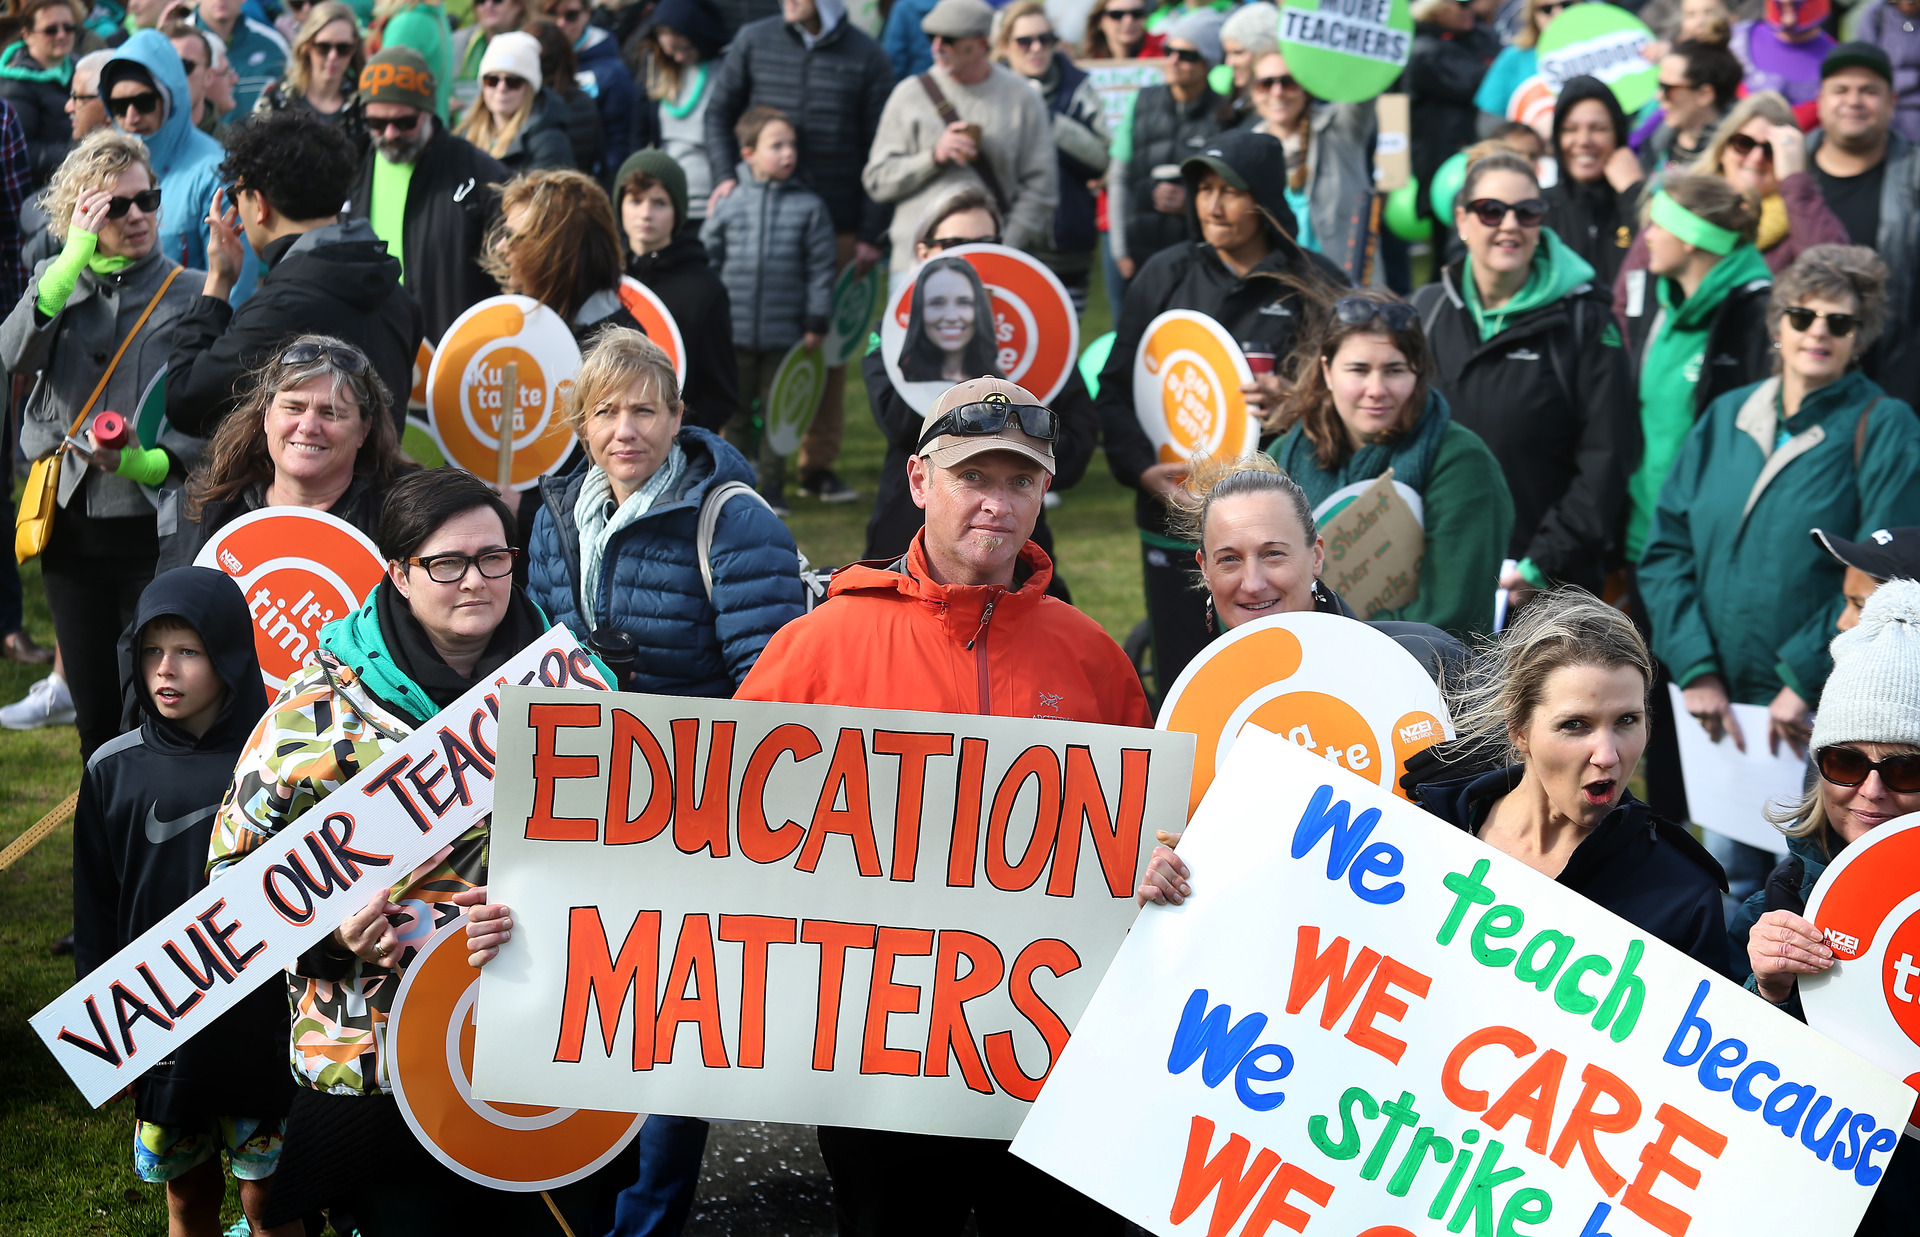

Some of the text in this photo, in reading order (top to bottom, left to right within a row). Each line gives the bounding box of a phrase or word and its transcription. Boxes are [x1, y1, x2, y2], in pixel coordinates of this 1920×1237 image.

[1287, 12, 1405, 60] TEACHERS
[1544, 38, 1647, 85] Suppor
[472, 361, 517, 387] Ku
[519, 385, 542, 408] te
[1331, 491, 1391, 561] Student
[220, 548, 244, 573] NZEI
[1365, 571, 1410, 616] make
[1399, 720, 1432, 740] NZEI
[523, 703, 1151, 898] EDUCATION
[57, 897, 267, 1068] VALUE
[263, 812, 394, 926] OUR
[1824, 927, 1860, 950] NZEI
[552, 906, 1082, 1103] MATTERS
[1290, 785, 1898, 1187] We teach because
[1286, 925, 1728, 1237] WE CARE
[1167, 989, 1552, 1237] We strike
